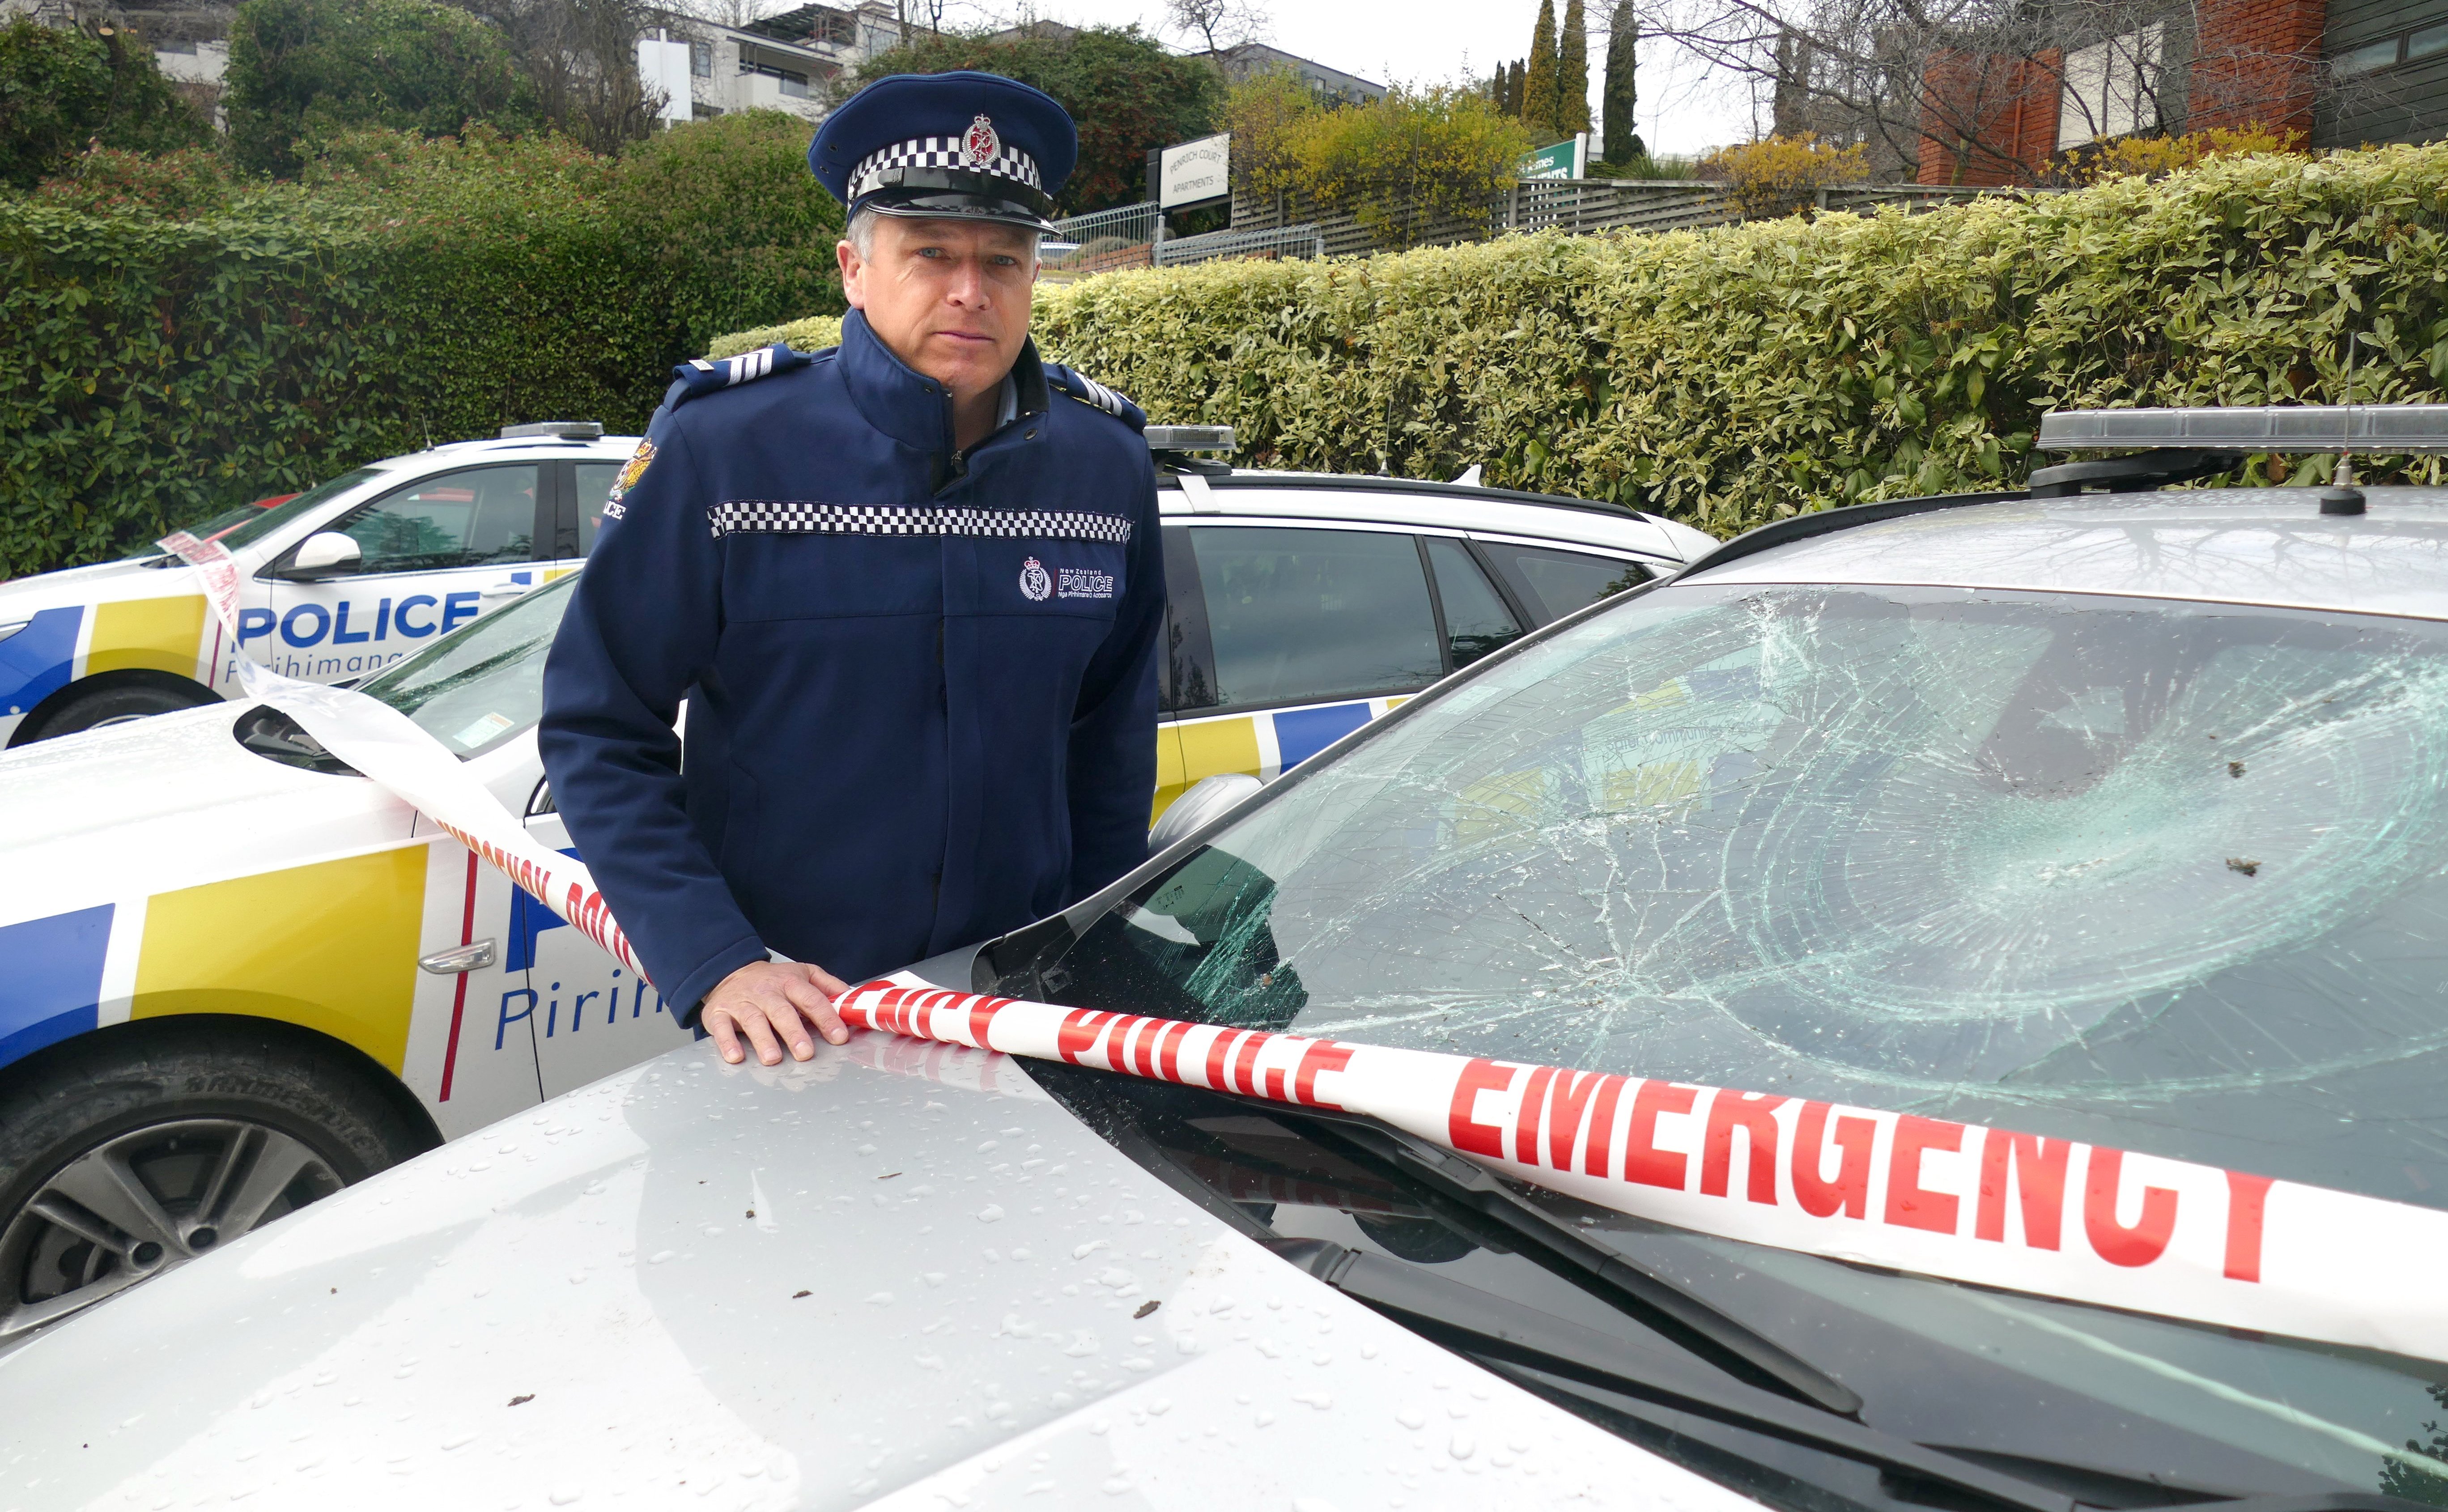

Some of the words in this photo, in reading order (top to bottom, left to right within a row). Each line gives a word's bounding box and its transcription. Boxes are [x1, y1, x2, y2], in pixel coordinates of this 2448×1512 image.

[1169, 151, 1198, 174] PENRICH
[1199, 149, 1221, 164] COURT
[1173, 175, 1214, 193] APARTMENTS
[1058, 575, 1114, 592] POLICE
[230, 591, 480, 653] POLICE
[1448, 1057, 2274, 1283] EMERGENCY
